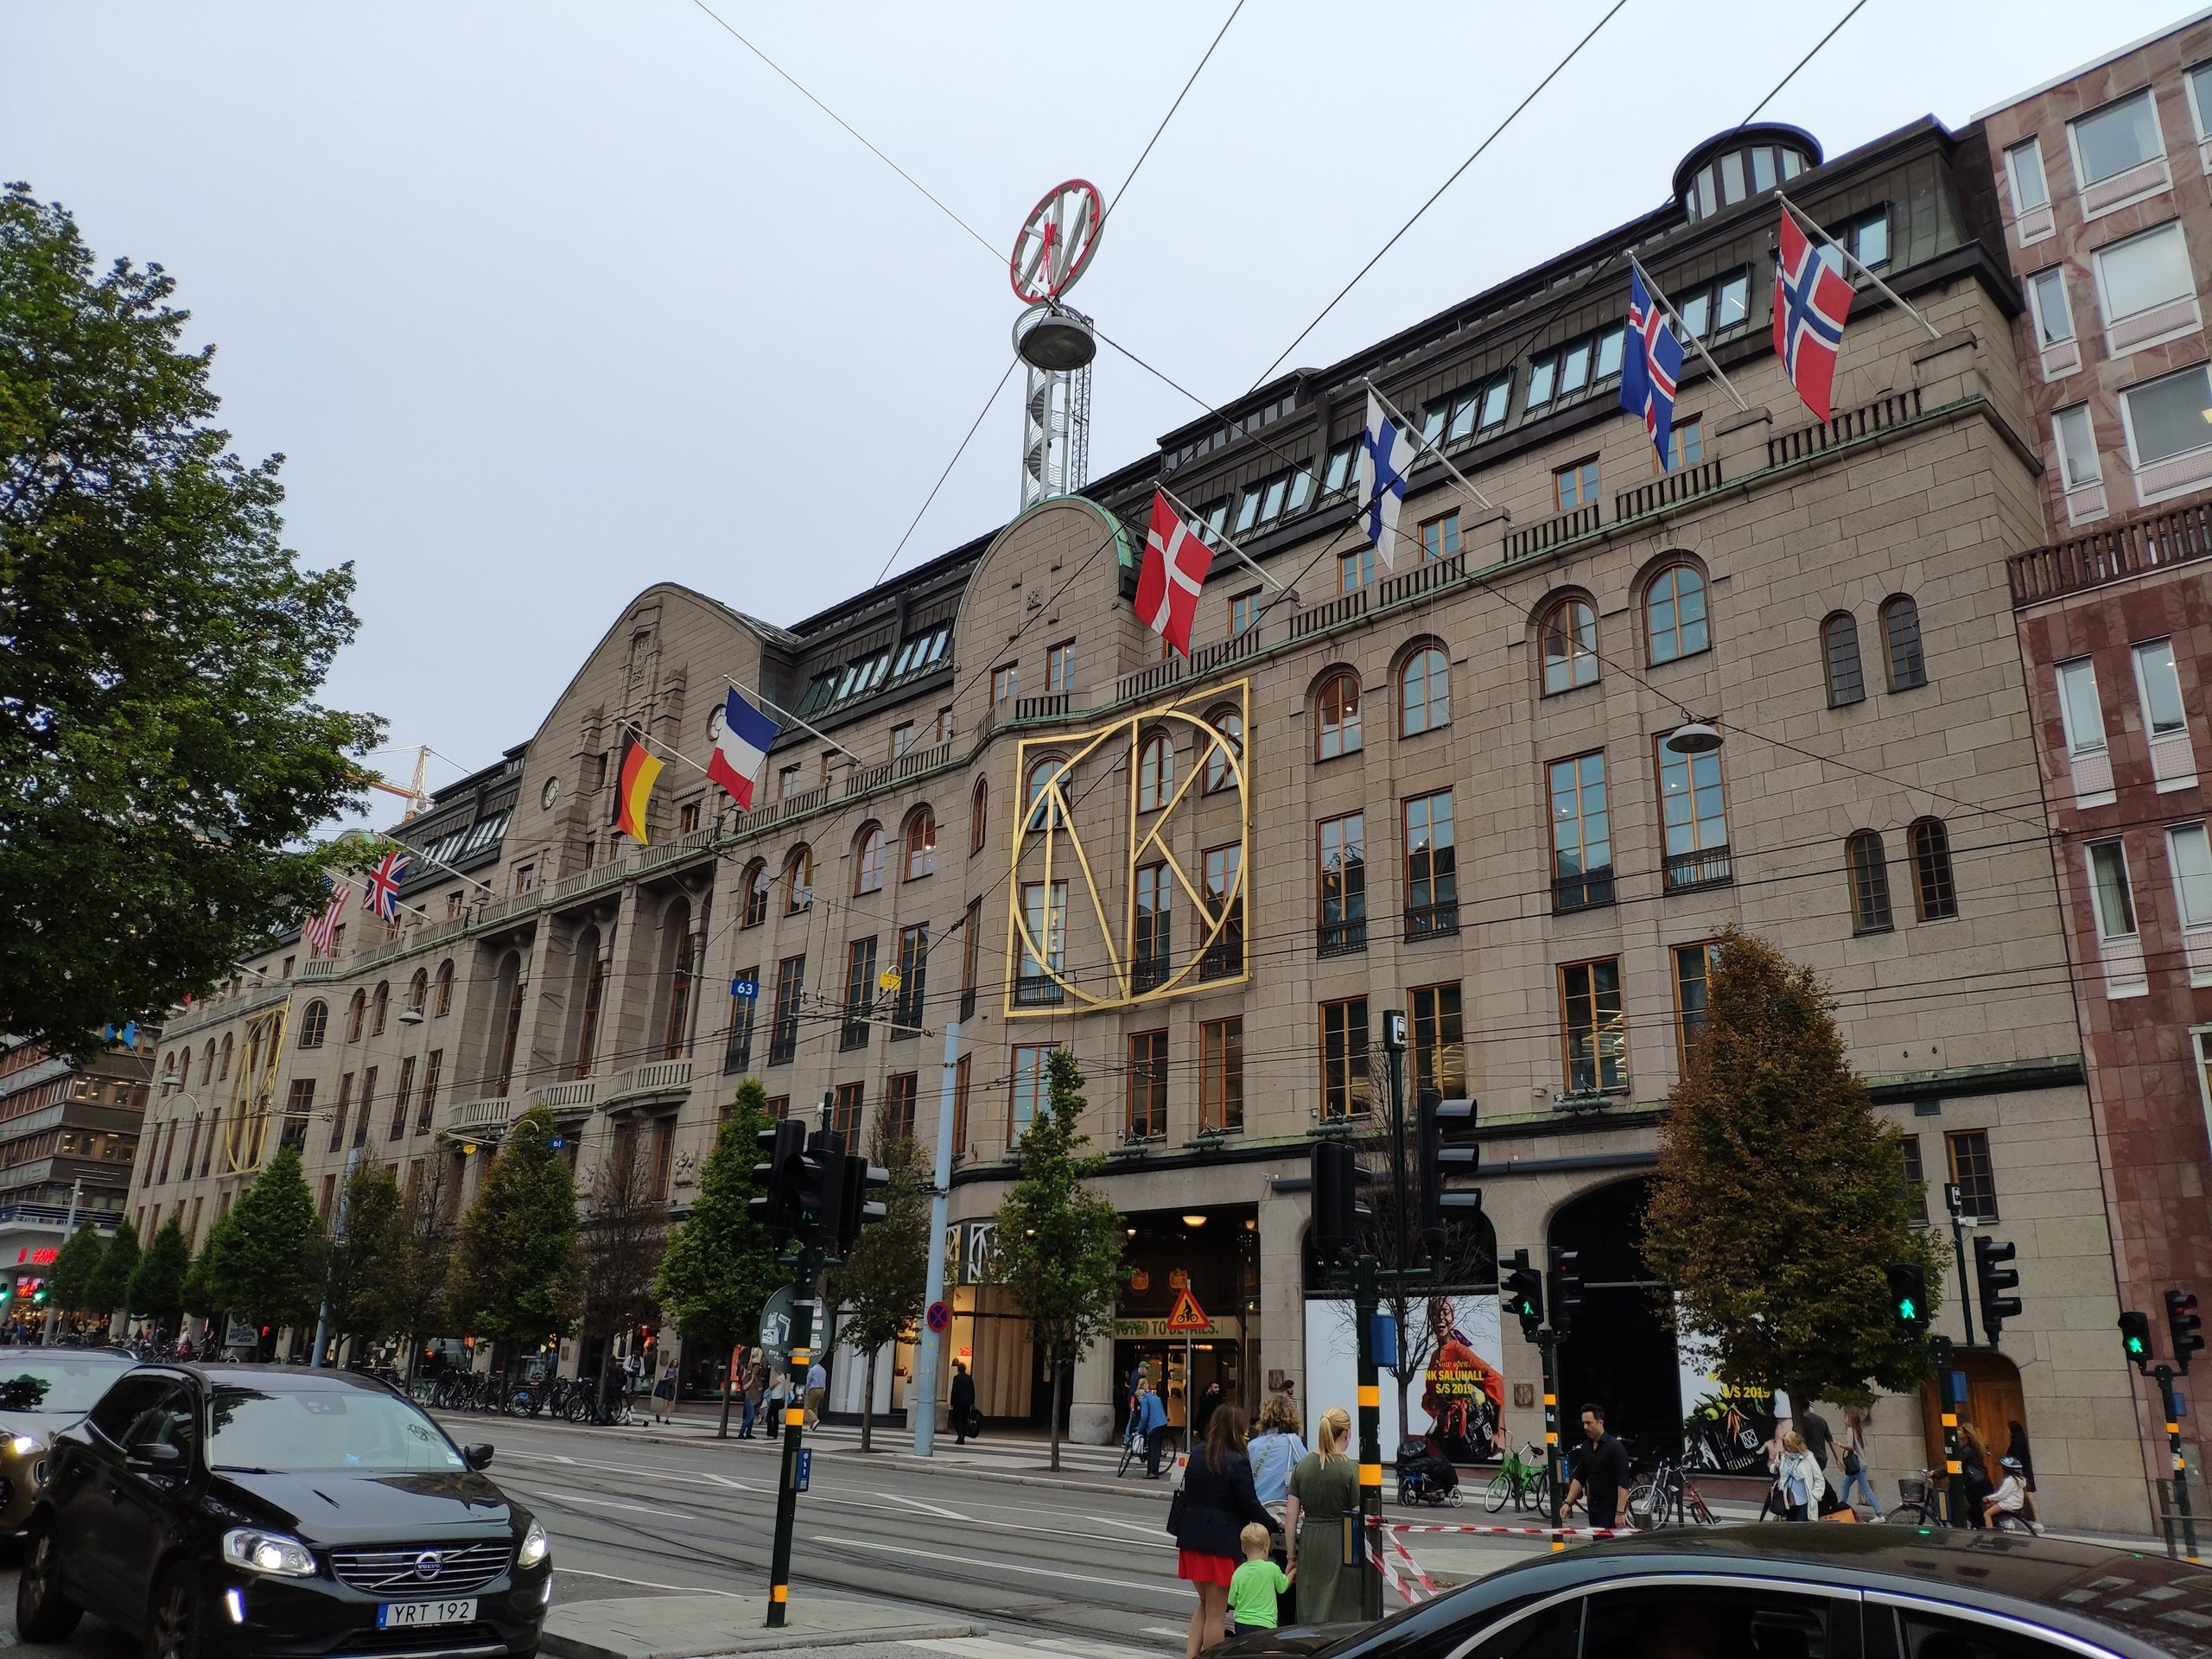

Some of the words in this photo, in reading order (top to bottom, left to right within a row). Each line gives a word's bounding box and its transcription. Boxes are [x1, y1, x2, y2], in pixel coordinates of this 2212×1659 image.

[1009, 702, 1249, 1009] NK
[737, 982, 753, 995] 63
[1152, 1320, 1166, 1335] TO
[1425, 1370, 1437, 1381] NK
[1438, 1370, 1484, 1381] SALUHALL
[1435, 1383, 1451, 1394] S/S
[1452, 1383, 1474, 1394] 2019
[1739, 1428, 1759, 1449] NK
[395, 1604, 429, 1624] YRT
[438, 1601, 469, 1620] 192
